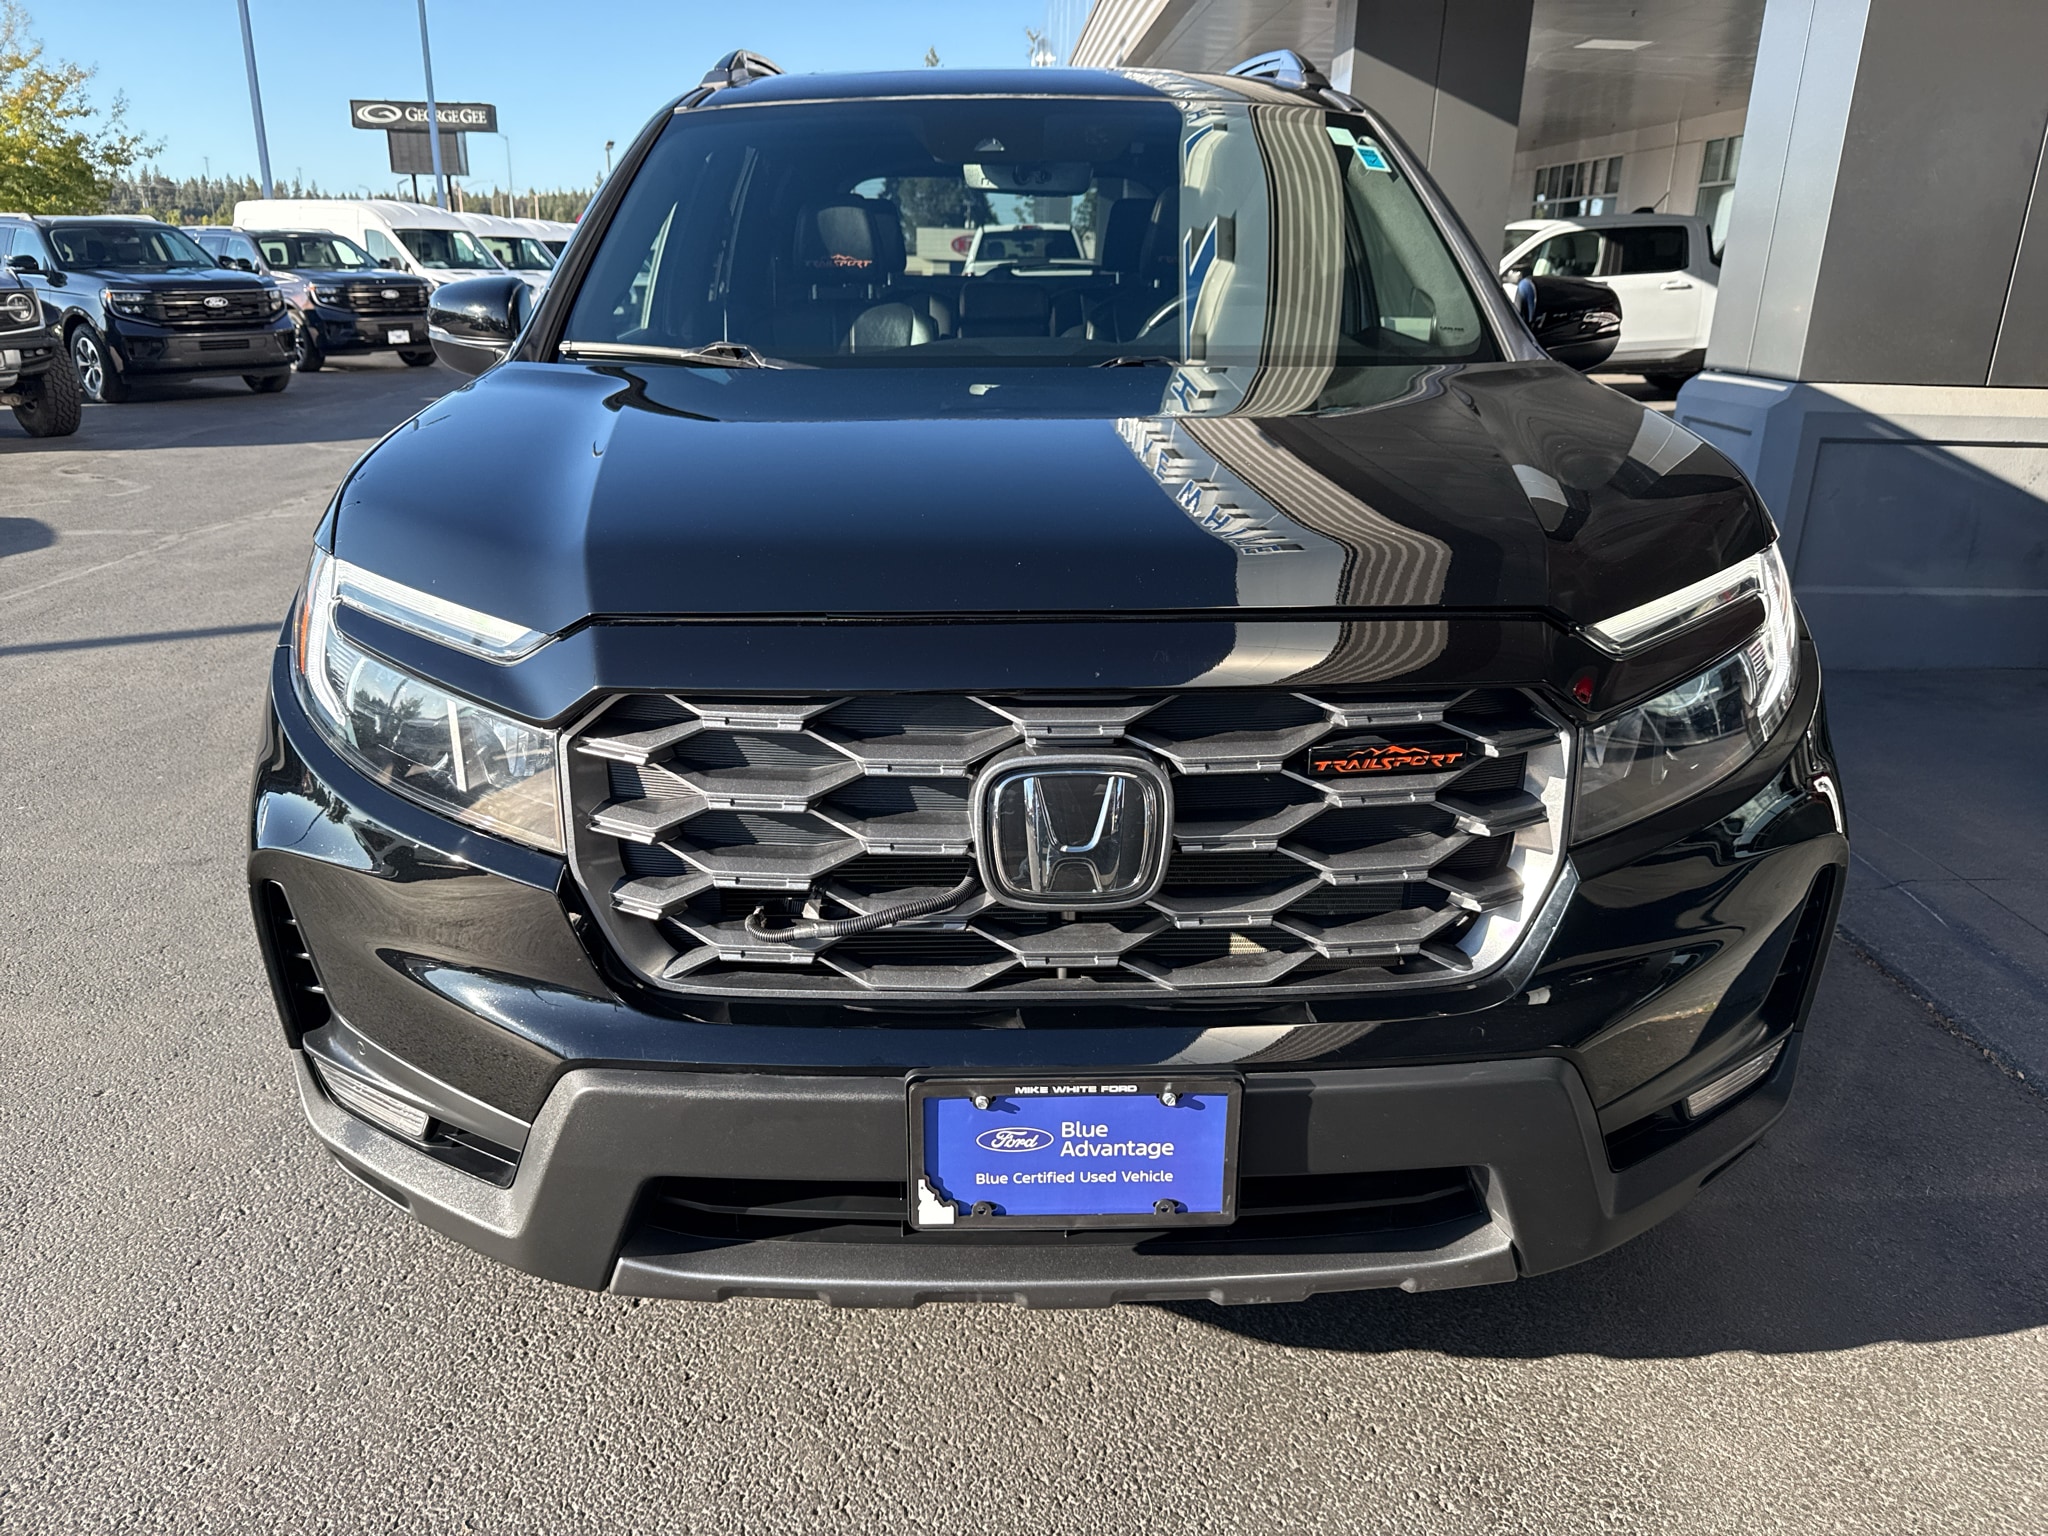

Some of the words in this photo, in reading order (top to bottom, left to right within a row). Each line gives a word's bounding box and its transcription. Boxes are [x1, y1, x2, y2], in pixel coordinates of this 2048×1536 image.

[460, 108, 487, 124] GEE
[1314, 752, 1463, 773] TRAILSPORT
[1014, 1086, 1049, 1094] MIKE
[1052, 1085, 1097, 1093] WHITE
[1100, 1084, 1138, 1093] FORD
[1061, 1121, 1109, 1138] Blue
[990, 1130, 1040, 1149] Ford
[1060, 1140, 1175, 1160] Advantage
[975, 1173, 1009, 1185] Blue
[1013, 1171, 1075, 1184] Certified
[1079, 1170, 1117, 1183] Used
[1121, 1169, 1174, 1183] Vehicle
